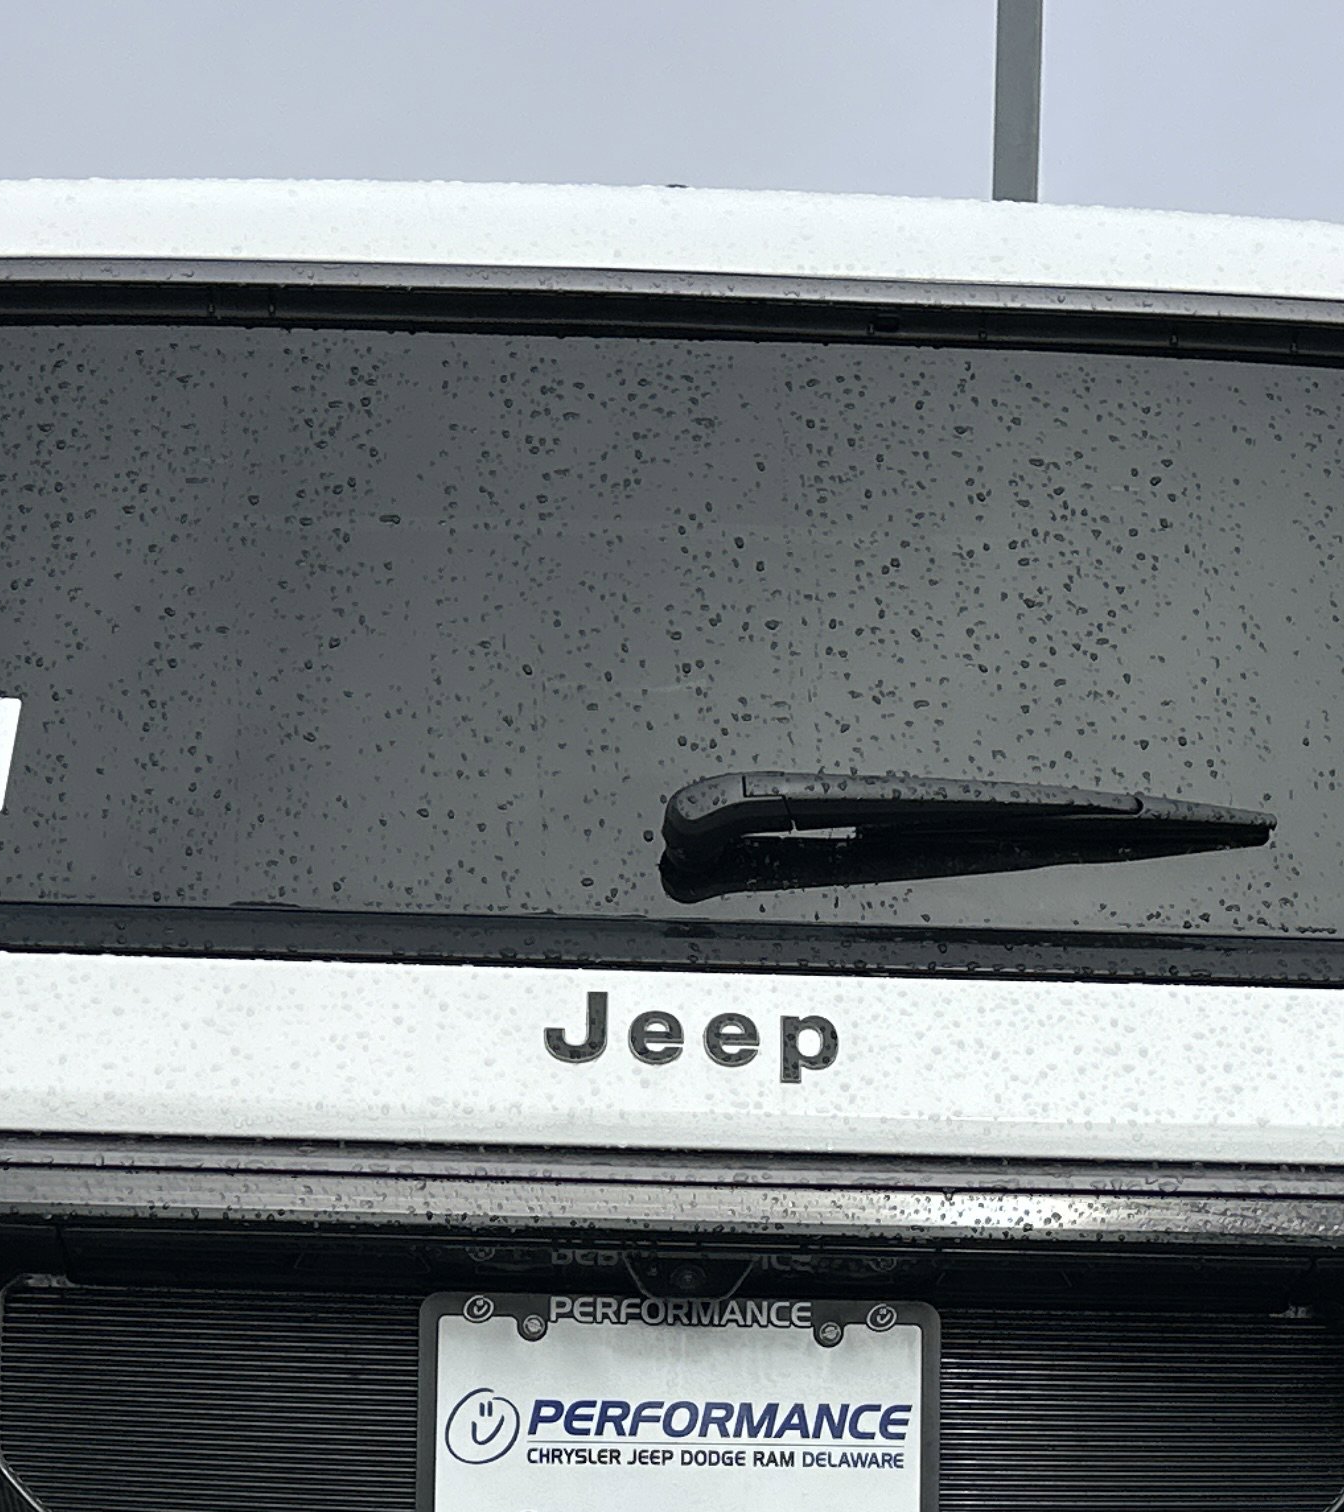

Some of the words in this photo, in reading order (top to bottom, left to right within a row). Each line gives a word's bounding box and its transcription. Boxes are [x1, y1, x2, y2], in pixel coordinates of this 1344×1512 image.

[544, 991, 839, 1084] Jeep
[549, 1296, 812, 1328] PERFORMANCE
[528, 1399, 913, 1441] PERFORMANCE
[527, 1447, 622, 1465] CHRYSLER
[626, 1449, 674, 1466] JEEP
[680, 1449, 746, 1467] DODGE
[753, 1450, 795, 1468] RAM
[802, 1451, 905, 1469] DELAWARE
